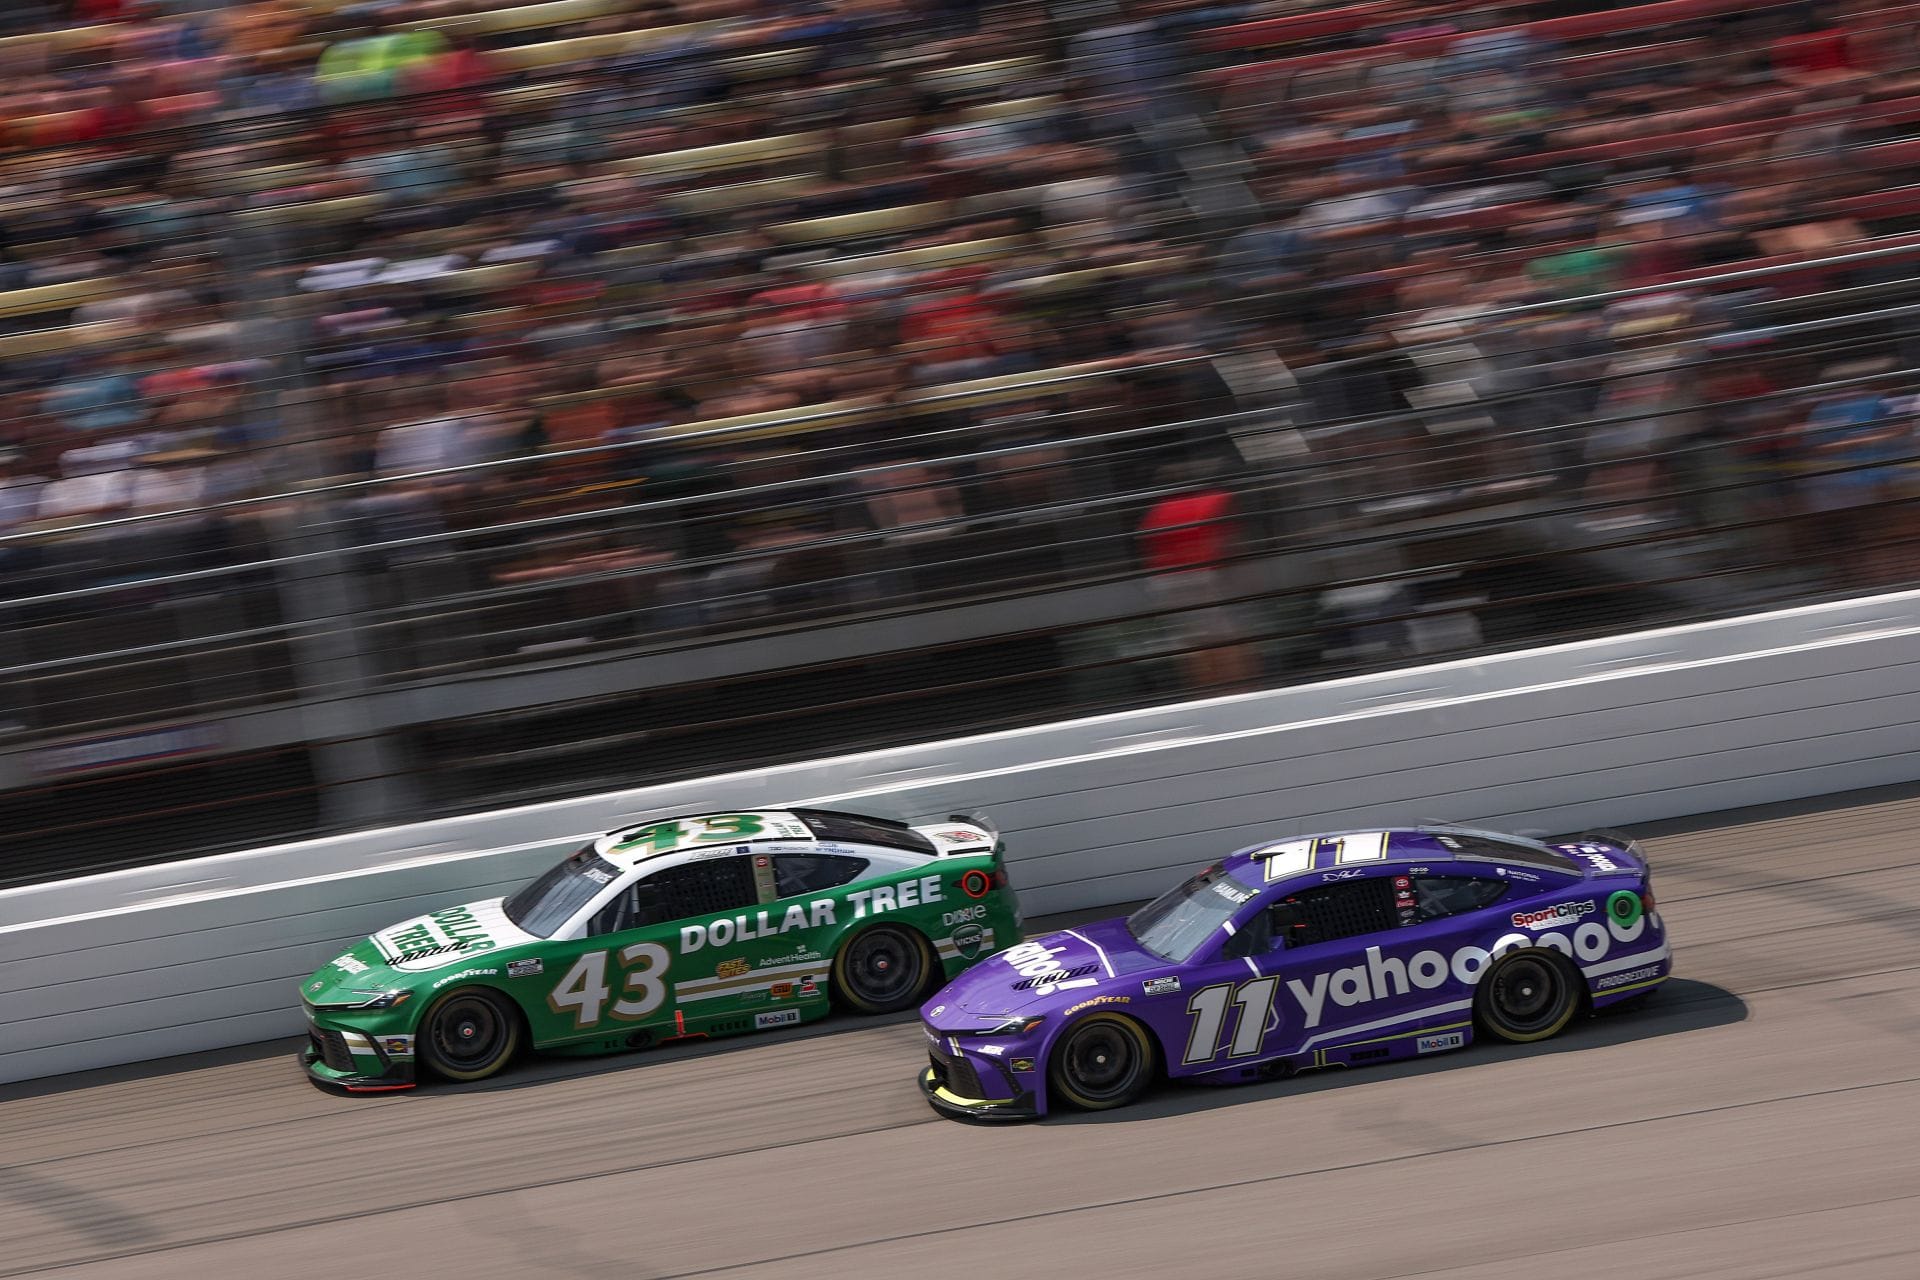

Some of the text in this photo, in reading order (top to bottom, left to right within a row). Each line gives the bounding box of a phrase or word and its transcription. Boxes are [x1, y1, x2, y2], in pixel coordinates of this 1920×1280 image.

[607, 815, 765, 855] 43
[1251, 832, 1388, 882] 11
[680, 874, 942, 955] DOLLAR TREE
[1512, 901, 1595, 928] SportClips
[387, 923, 446, 956] TREE
[429, 906, 497, 955] DOLLAR
[955, 936, 982, 947] VICKS
[759, 950, 822, 967] AdventHealth
[433, 968, 498, 988] GOODYEAR
[548, 942, 671, 1028] 43
[758, 1014, 786, 1026] Mobil
[1063, 995, 1131, 1016] GOODYEAR
[1182, 975, 1279, 1065] 11
[1421, 1037, 1450, 1050] Mobil
